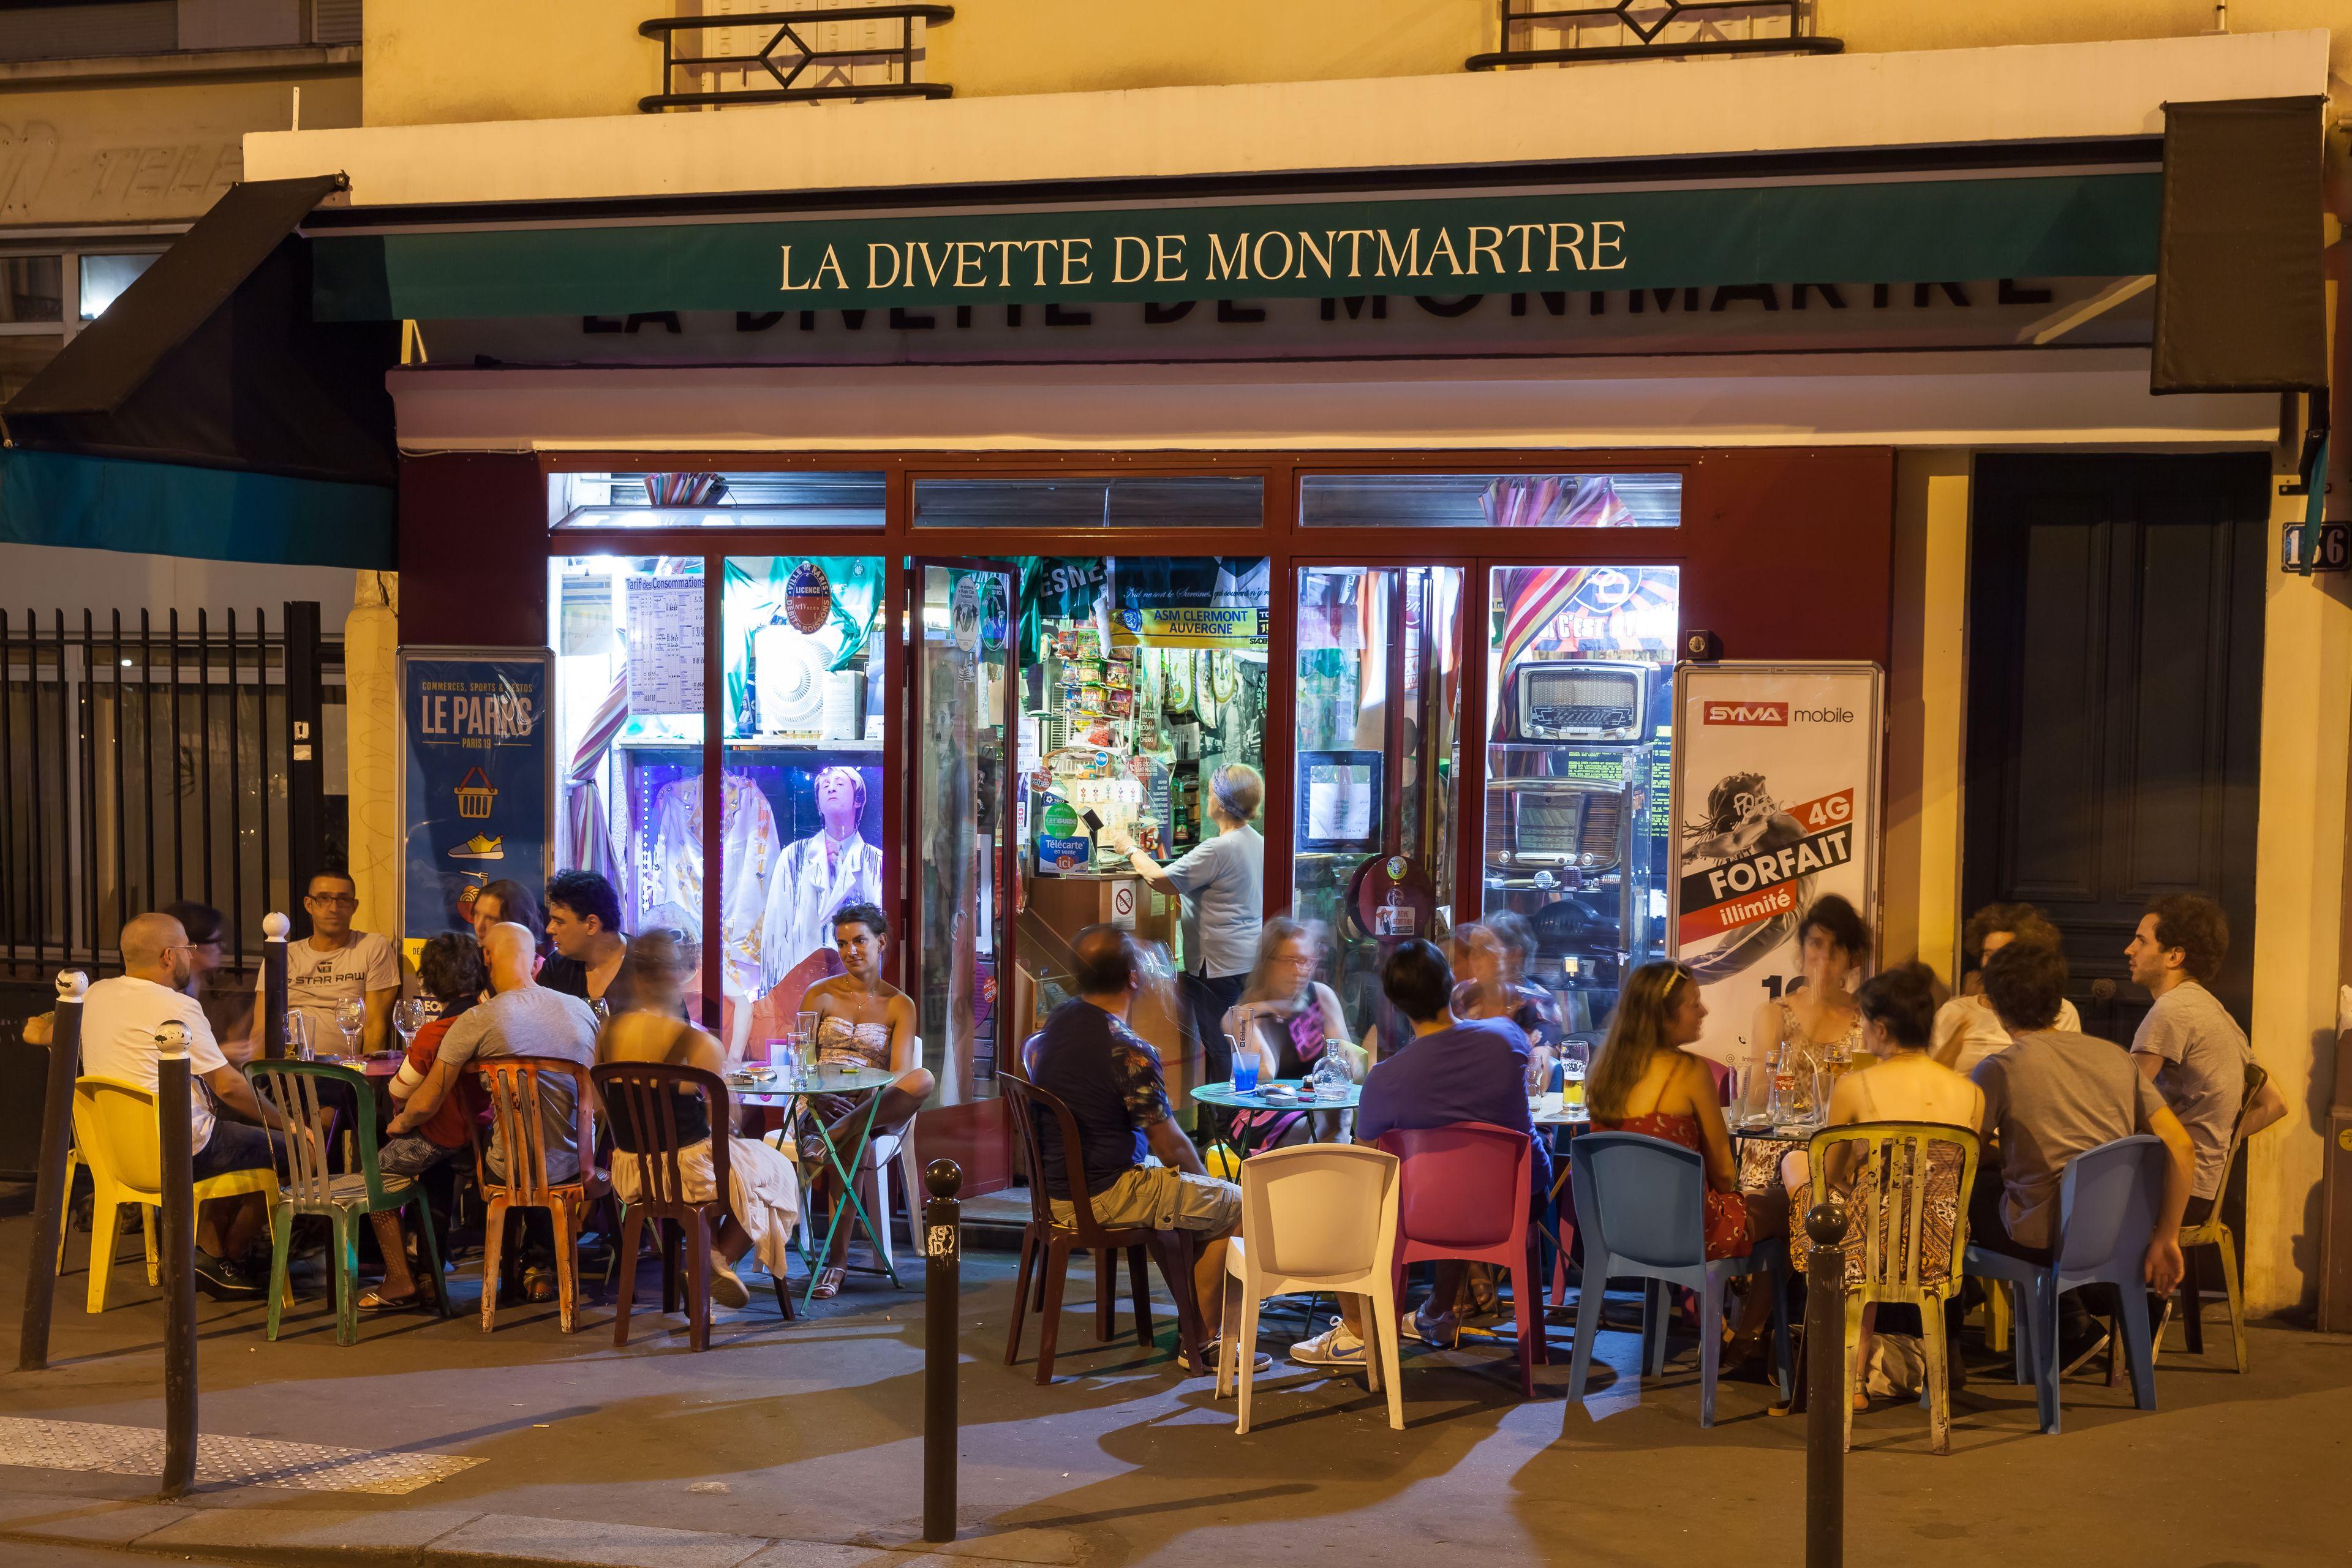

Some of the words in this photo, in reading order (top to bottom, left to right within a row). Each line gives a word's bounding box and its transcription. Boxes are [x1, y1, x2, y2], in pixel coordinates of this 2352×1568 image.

[780, 243, 850, 290] LA
[867, 238, 1093, 288] DIVETTE
[1112, 235, 1188, 284] DE
[1205, 221, 1627, 281] MONTMARTRE
[626, 578, 641, 589] Tarif
[643, 580, 651, 589] des
[652, 576, 704, 589] Consommations
[787, 568, 802, 590] VILLE
[812, 564, 829, 590] PARIS
[1123, 586, 1141, 598] Nul
[802, 600, 830, 632] BOISSONS
[1154, 609, 1180, 622] ASM
[1183, 609, 1248, 622] CLERMONT
[1169, 623, 1232, 635] AUVERGNE
[422, 681, 467, 692] COMMERCES,
[470, 683, 496, 692] SPORTS
[422, 695, 447, 734] LE
[453, 696, 532, 736] PARKS
[1709, 706, 1782, 722] SYMA
[1794, 707, 1854, 723] mobile
[462, 738, 482, 748] PARIS
[483, 738, 491, 749] 19
[1809, 796, 1850, 826] 4G
[1046, 839, 1083, 850] Télécarte
[1058, 857, 1071, 869] ici
[1708, 831, 1847, 900] FORFAIT
[1720, 888, 1791, 925] illimité
[336, 972, 365, 981] RAW
